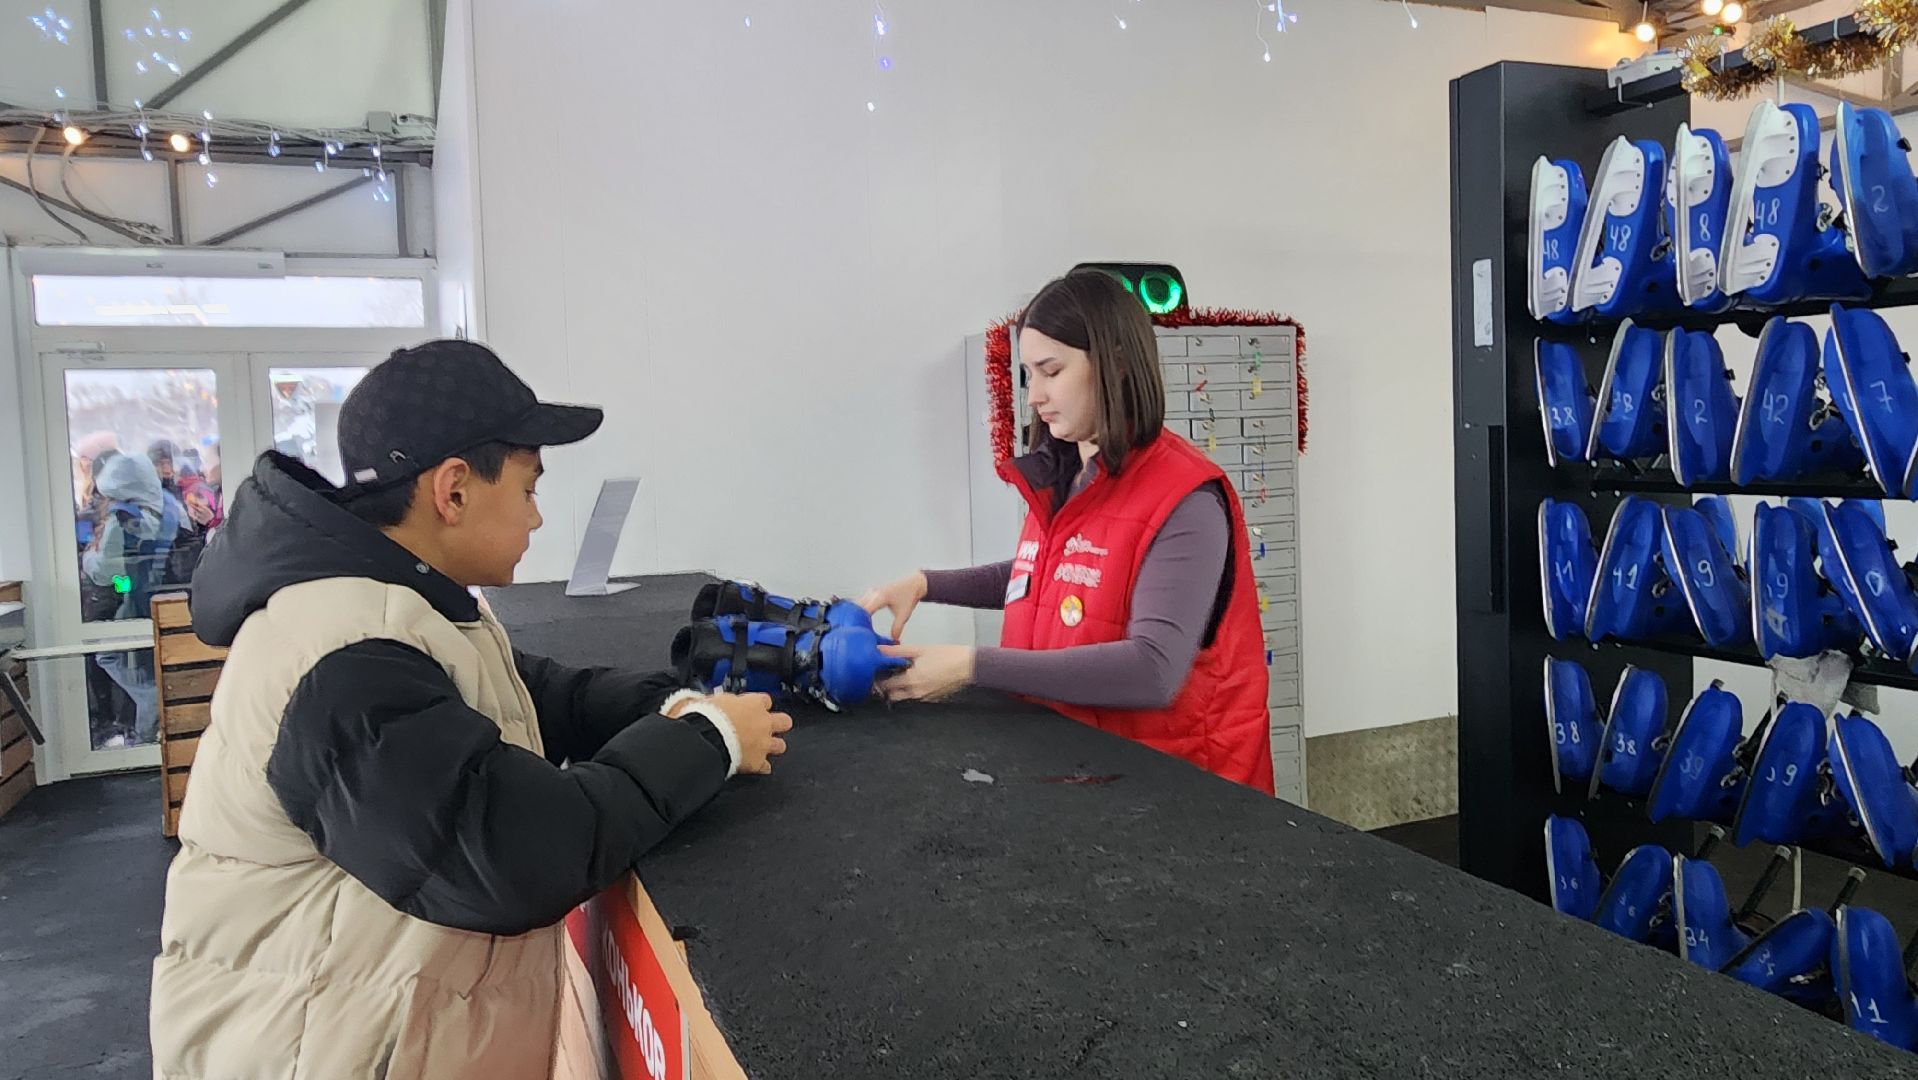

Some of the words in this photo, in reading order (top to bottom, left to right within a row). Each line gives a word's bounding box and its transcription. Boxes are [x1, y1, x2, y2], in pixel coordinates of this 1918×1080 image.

[1871, 184, 1889, 213] 2
[1755, 197, 1781, 231] 48
[1543, 238, 1559, 261] 48
[1610, 223, 1632, 252] 48
[1551, 405, 1576, 427] 38
[1694, 398, 1708, 425] 2
[1763, 388, 1789, 425] 42
[1612, 562, 1638, 592] 41
[1555, 720, 1580, 745] 38
[1615, 731, 1637, 756] 38
